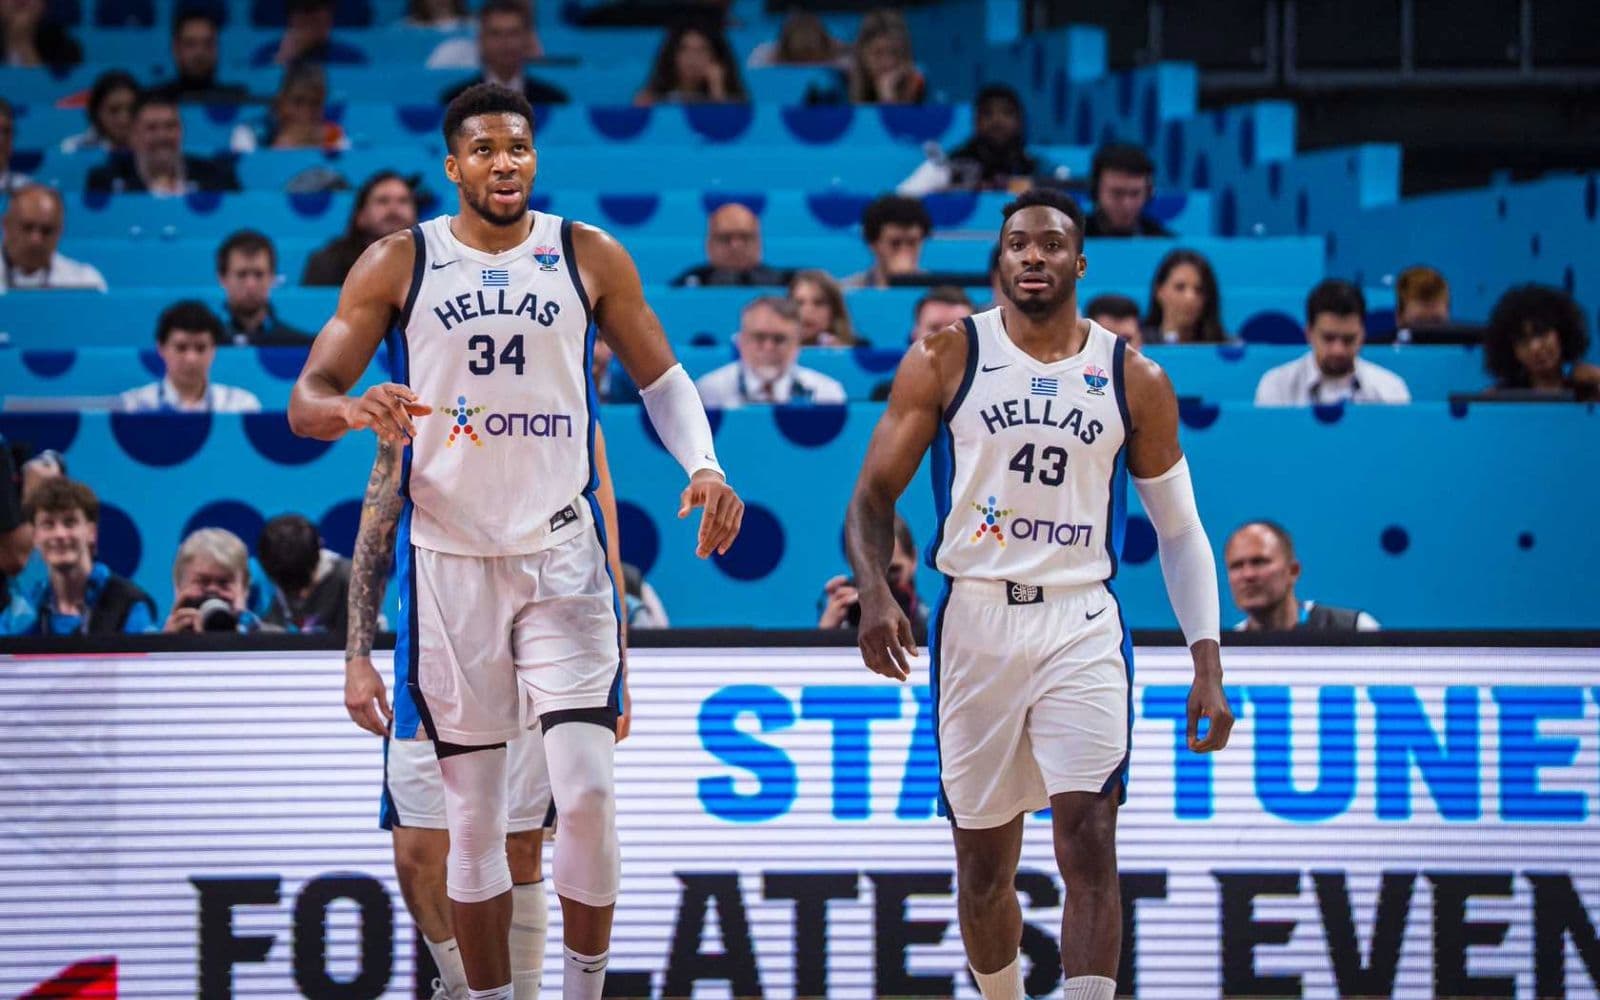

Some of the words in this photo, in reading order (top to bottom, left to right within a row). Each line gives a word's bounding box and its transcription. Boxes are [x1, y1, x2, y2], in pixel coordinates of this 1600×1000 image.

[434, 290, 561, 330] HELLAS
[468, 334, 526, 376] 34
[980, 398, 1104, 446] HELLAS
[1009, 443, 1069, 487] 43
[697, 684, 1053, 822] ST
[1141, 685, 1600, 821] TUNE
[190, 872, 446, 1000] FO
